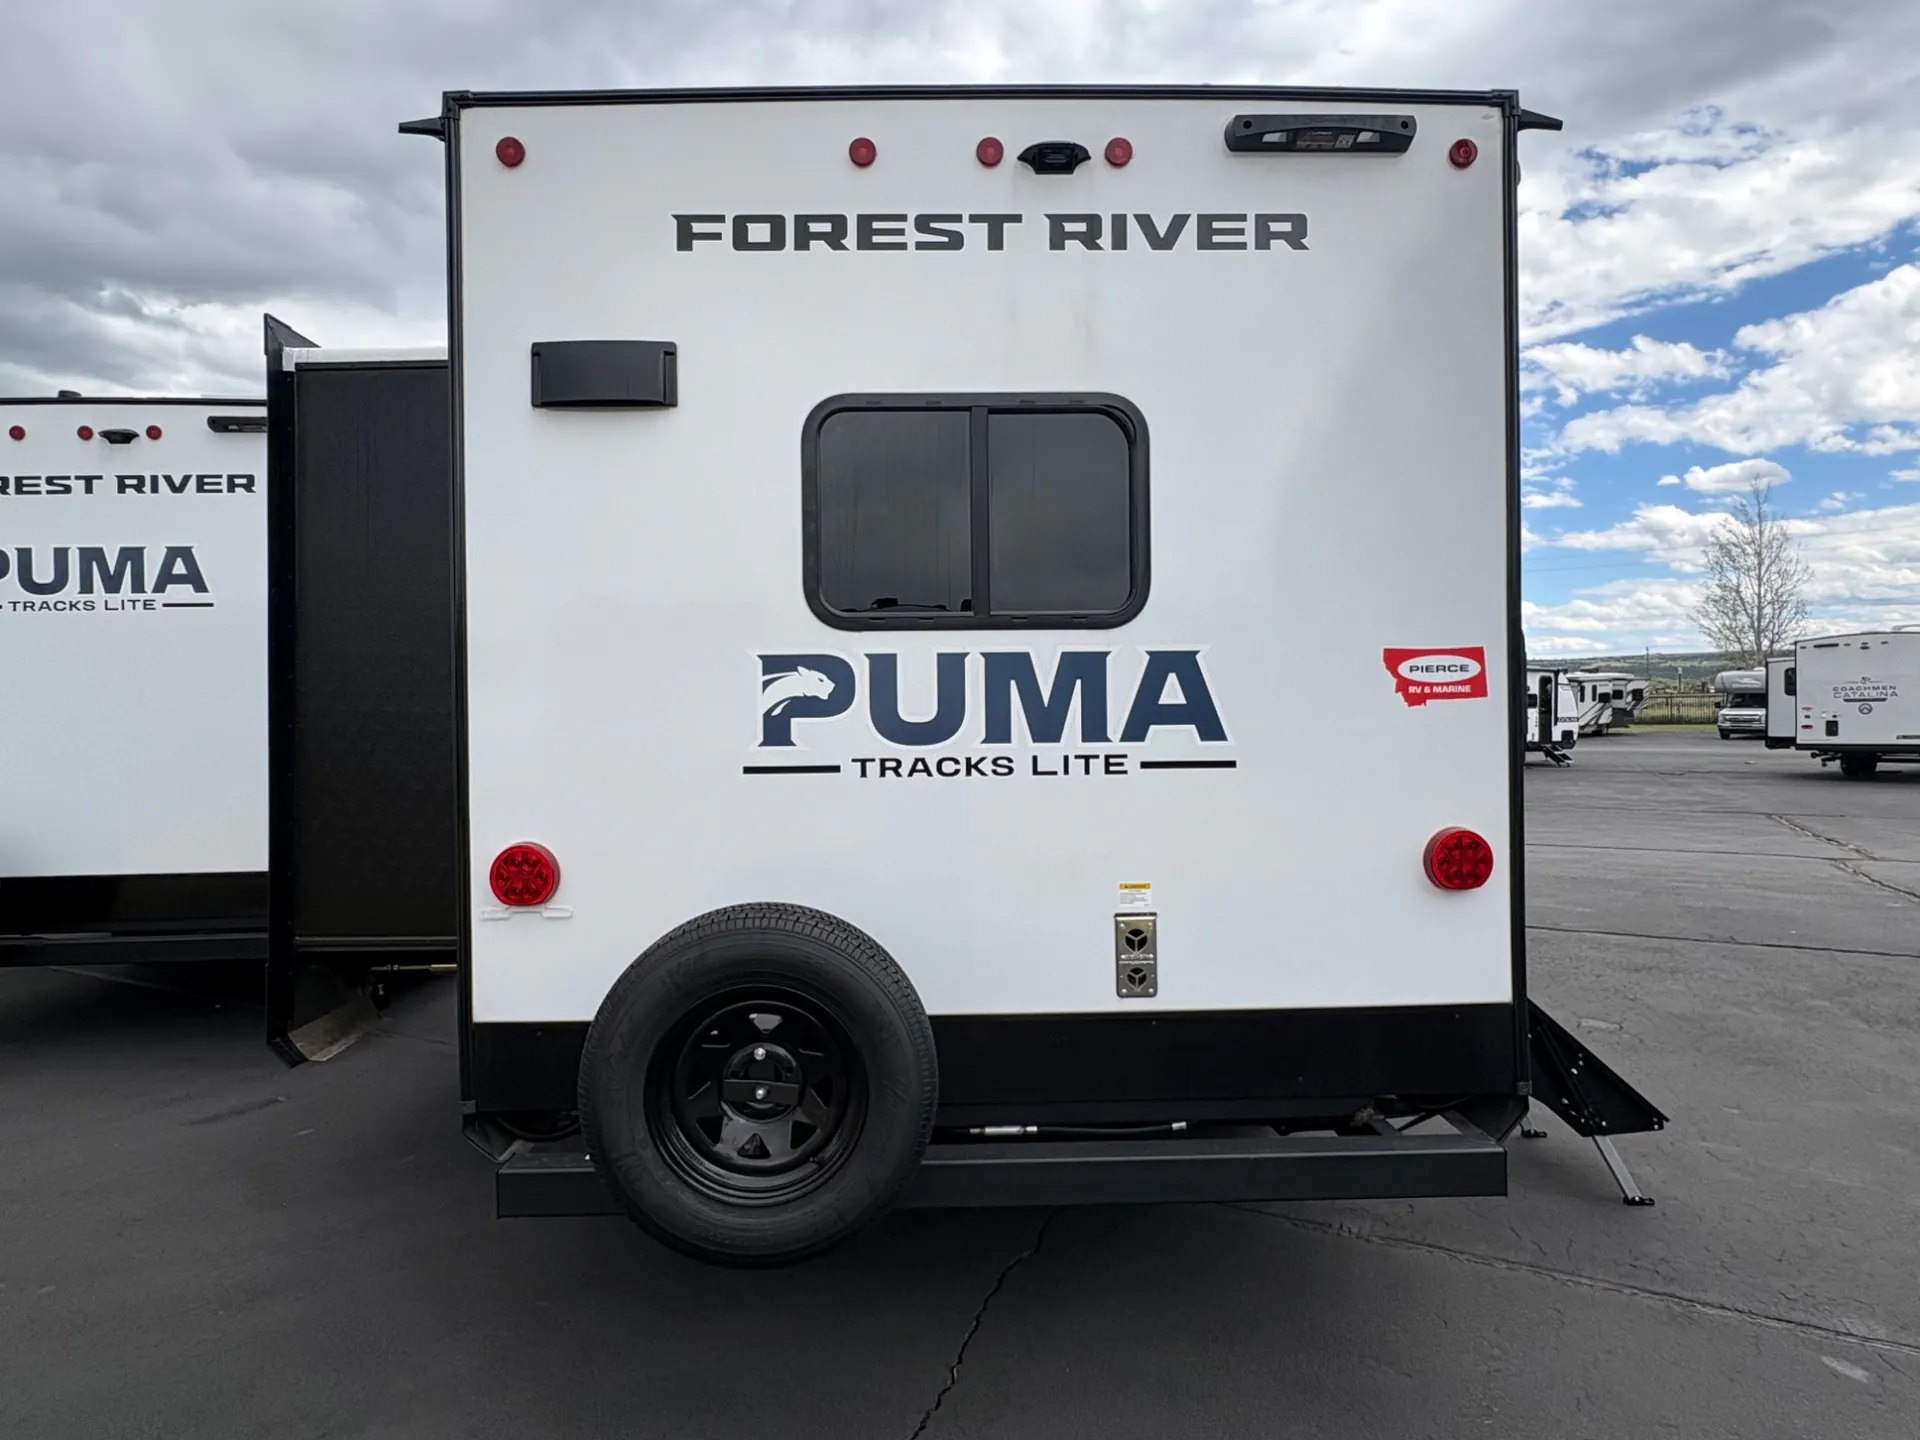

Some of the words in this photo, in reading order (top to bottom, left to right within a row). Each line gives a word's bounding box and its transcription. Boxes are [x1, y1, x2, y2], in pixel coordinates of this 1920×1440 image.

[672, 213, 1022, 251] FOREST
[1044, 213, 1310, 251] RIVER
[115, 474, 256, 495] RIVER
[0, 545, 210, 596] UMA
[8, 600, 96, 612] TRACKS
[104, 599, 157, 611] LITE
[1409, 664, 1470, 673] PIERCE
[757, 650, 1229, 747] PUMA
[1408, 686, 1423, 694] RV
[1432, 685, 1472, 693] MARINE
[1833, 690, 1899, 699] CATALINA
[851, 756, 1015, 779] TRACKS
[1031, 753, 1129, 777] LITE
